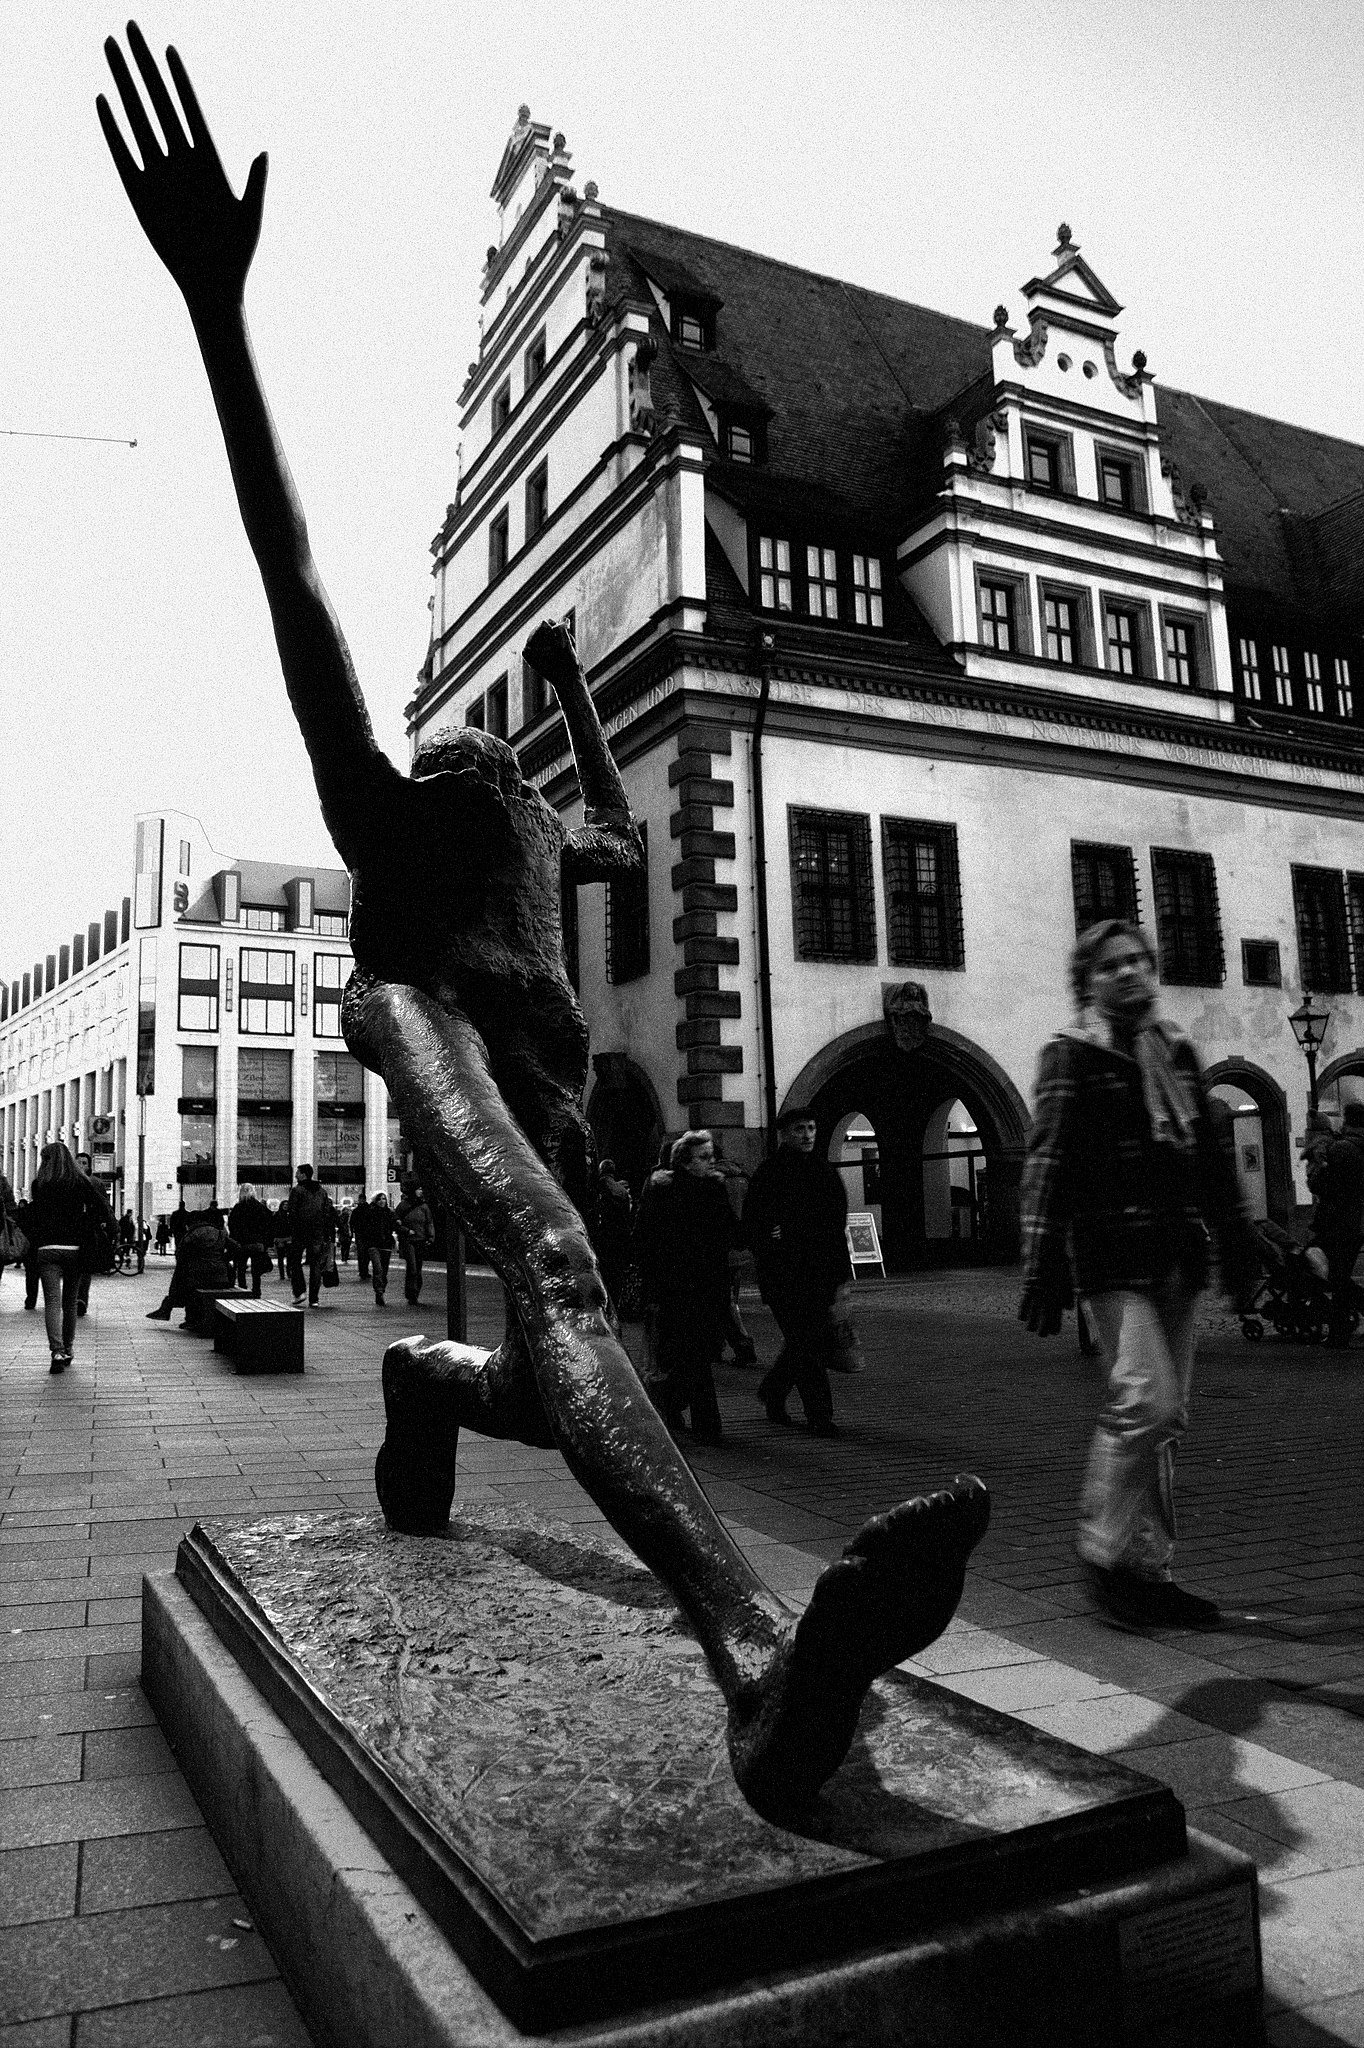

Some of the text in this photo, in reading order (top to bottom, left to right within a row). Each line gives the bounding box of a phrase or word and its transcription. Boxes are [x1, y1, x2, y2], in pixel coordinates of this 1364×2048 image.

[646, 677, 674, 709] UND
[703, 671, 814, 704] DASSLBE
[846, 692, 885, 714] DES
[908, 702, 967, 727] ENDE
[1032, 721, 1142, 754] NOVEMBRIS
